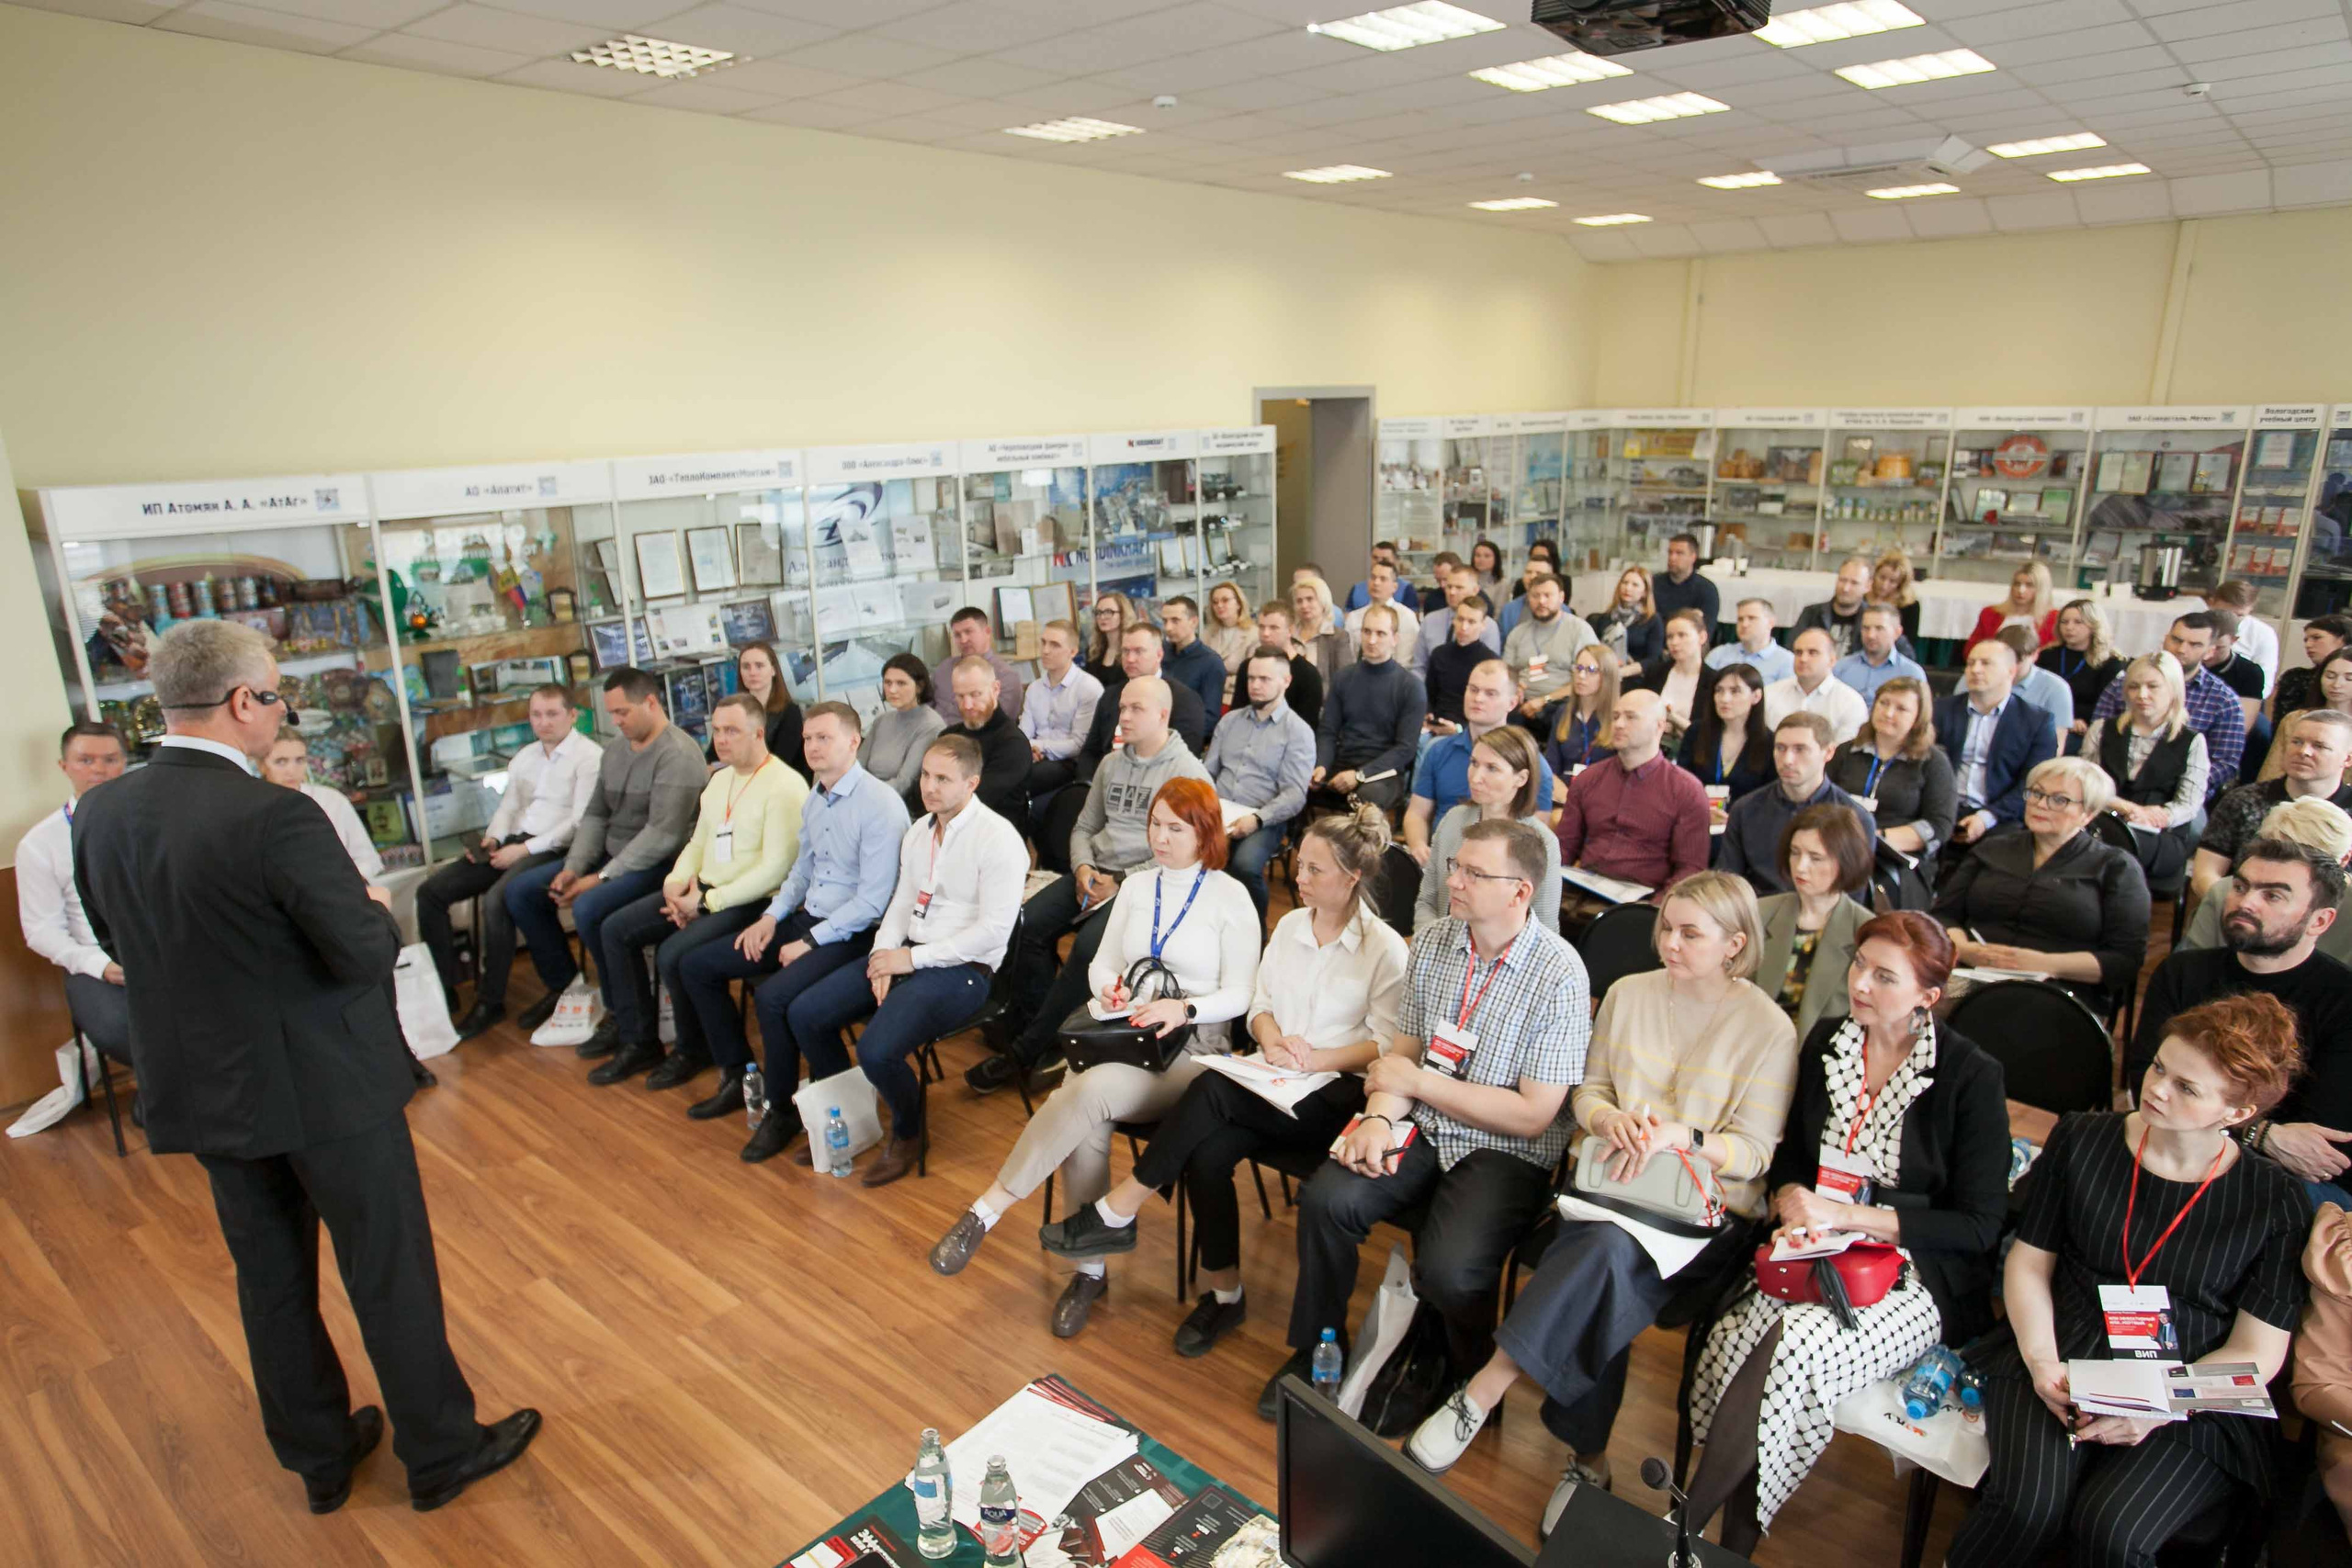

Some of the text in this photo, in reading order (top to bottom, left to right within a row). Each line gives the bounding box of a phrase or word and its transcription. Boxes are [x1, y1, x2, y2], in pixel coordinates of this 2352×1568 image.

[649, 475, 665, 485] ЗАО
[466, 484, 533, 496] АО «Апатит»
[142, 495, 308, 515] ИП Атомян А. А. «АтАг»
[2134, 1350, 2157, 1359] ВИП
